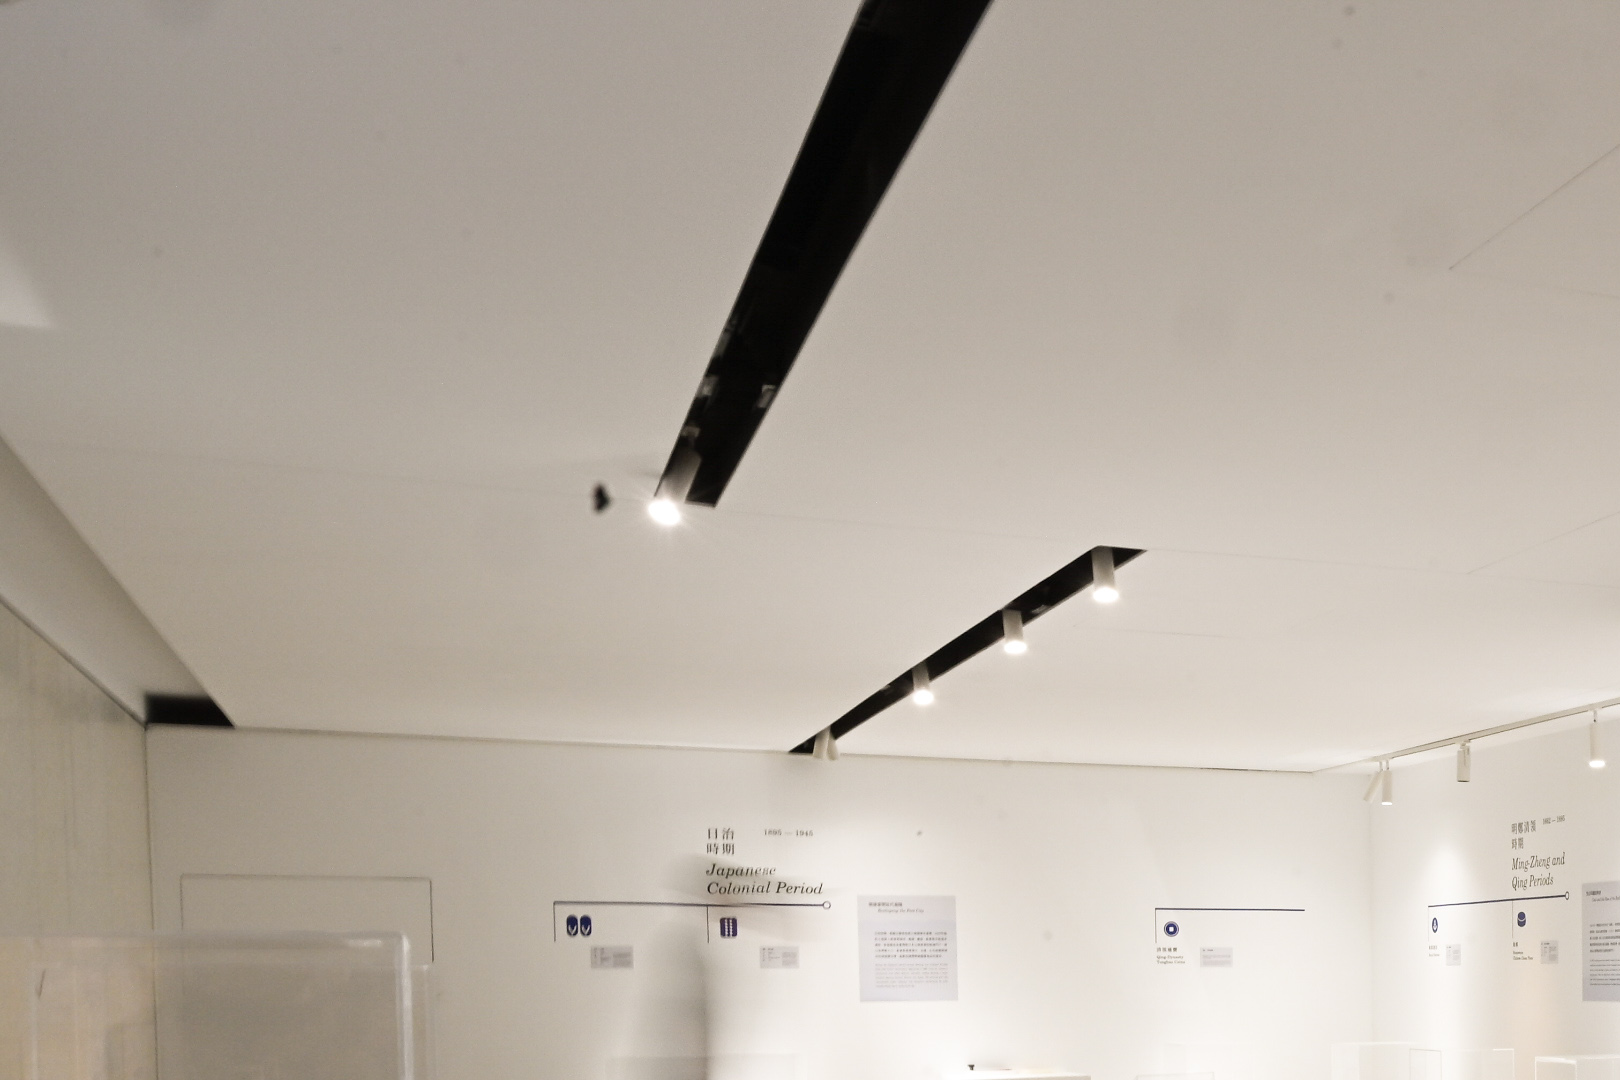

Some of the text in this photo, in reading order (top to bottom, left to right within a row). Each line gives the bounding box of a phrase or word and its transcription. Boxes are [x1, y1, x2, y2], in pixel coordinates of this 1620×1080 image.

[706, 827, 735, 841] 日治
[706, 842, 735, 856] 時期
[1511, 851, 1566, 873] Ming-Zheng and
[705, 862, 777, 880] Japanese
[707, 880, 824, 896] Colonial Period
[1511, 872, 1555, 891] Qing Periods
